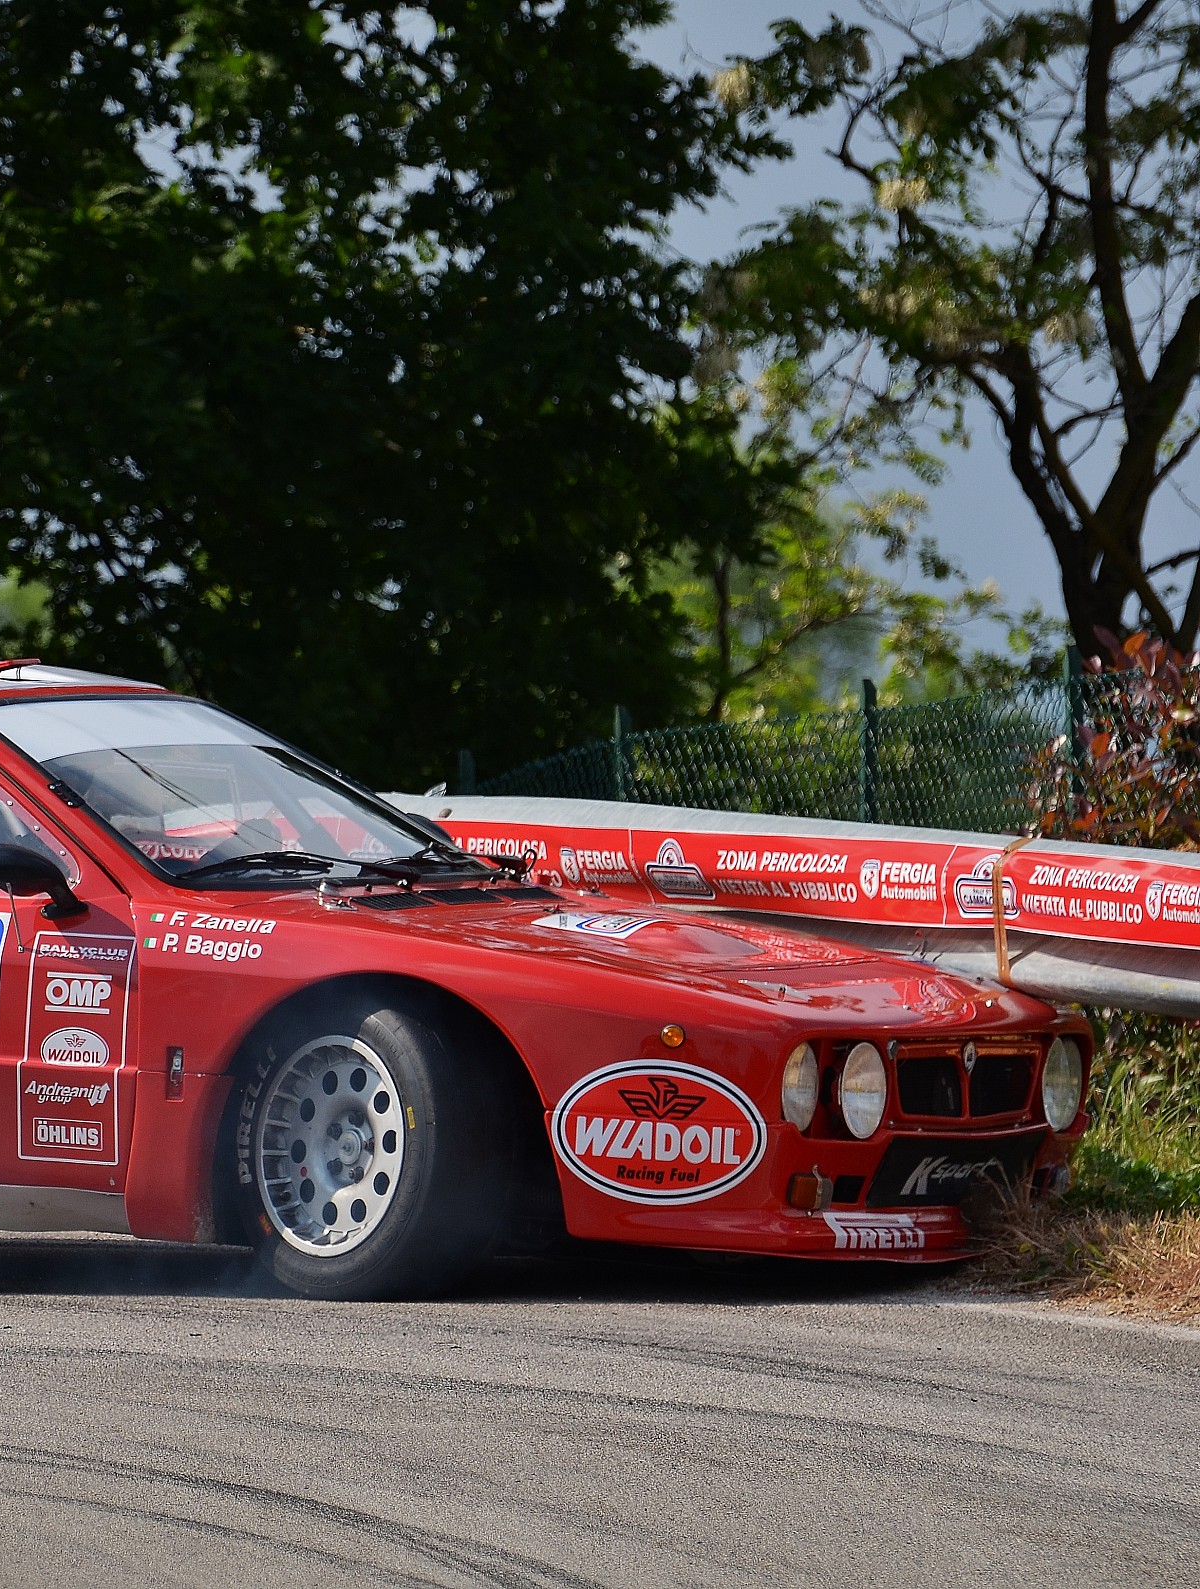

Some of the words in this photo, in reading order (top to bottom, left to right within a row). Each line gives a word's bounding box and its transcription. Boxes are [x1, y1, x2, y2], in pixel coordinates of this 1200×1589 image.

[467, 837, 548, 860] PERICOLOSA
[576, 849, 629, 871] FERGIA
[716, 850, 756, 871] ZONA
[759, 851, 848, 874] PERICOLOSA
[880, 862, 936, 885] FERGIA
[1028, 864, 1066, 887] ZONA
[1065, 868, 1141, 893] PERICOLOSA
[712, 878, 771, 897] VIETATA
[771, 881, 790, 898] AL
[789, 880, 858, 904] PUBBLICO
[880, 884, 937, 902] Automobili
[1021, 893, 1067, 917] VIETATA
[1069, 898, 1084, 918] AL
[1085, 899, 1143, 924] PUBBLICO
[169, 911, 185, 927] F.
[191, 912, 277, 935] Zanella
[161, 933, 178, 953] P.
[185, 935, 263, 962] Baggio
[45, 978, 111, 1007] OMP
[48, 1048, 101, 1063] WLADOIL
[24, 1080, 95, 1099] Andreani
[37, 1095, 72, 1104] group
[37, 1120, 99, 1146] ÖHLINS
[575, 1116, 741, 1165] WLADOIL
[616, 1165, 665, 1184] Racing
[669, 1168, 701, 1183] Fuel
[822, 1212, 925, 1249] PIRELLI
